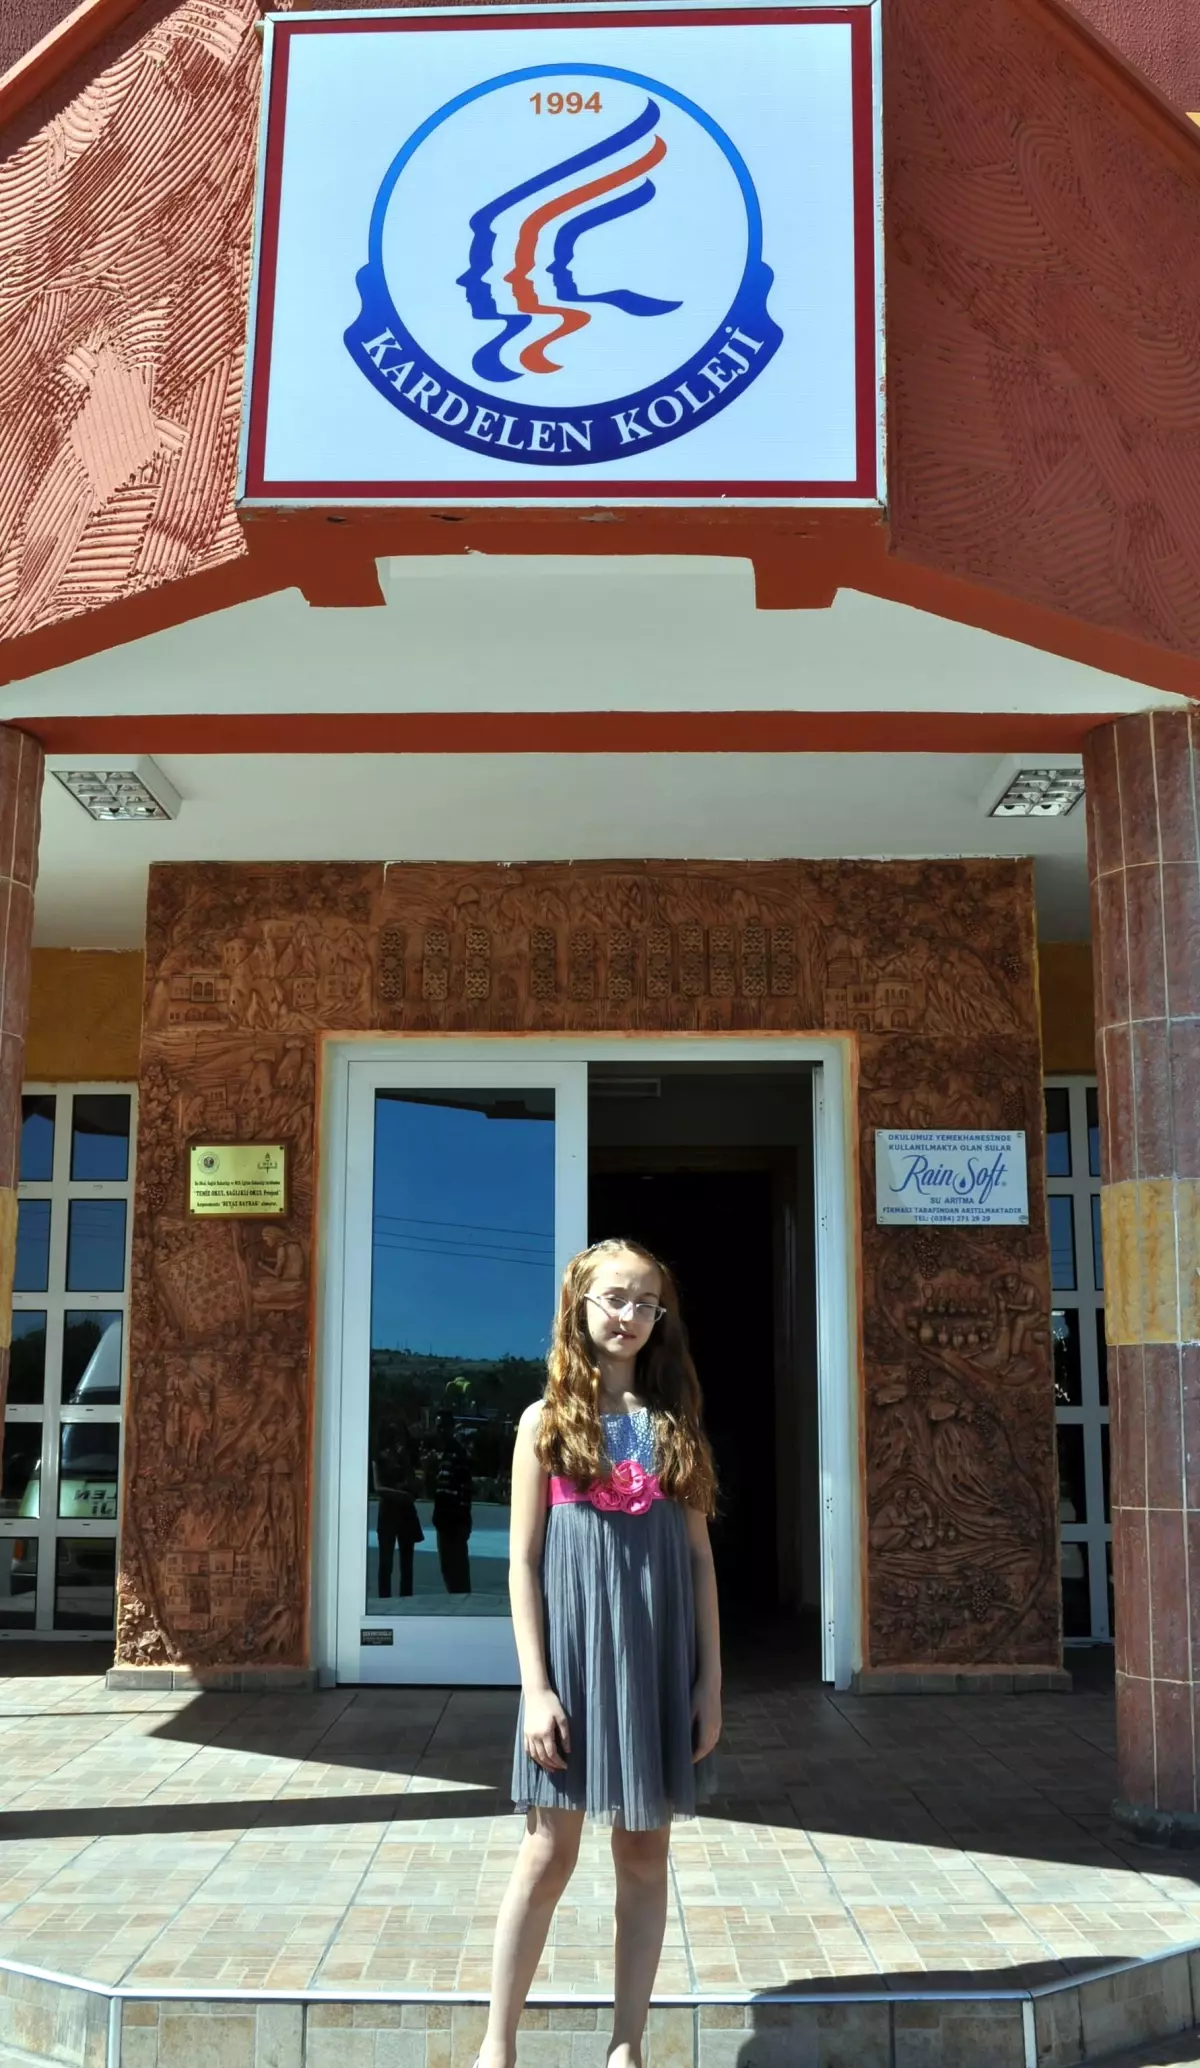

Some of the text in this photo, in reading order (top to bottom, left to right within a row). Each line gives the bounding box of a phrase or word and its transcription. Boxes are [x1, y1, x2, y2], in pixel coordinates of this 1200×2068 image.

[529, 91, 603, 115] 1994
[361, 324, 765, 453] KARDELEN KOLEJİ
[888, 1134, 1012, 1142] OKULUMUZ YEMEKHANESİNDE
[984, 1144, 1012, 1152] SULAR
[889, 1152, 1009, 1205] Rain Soft
